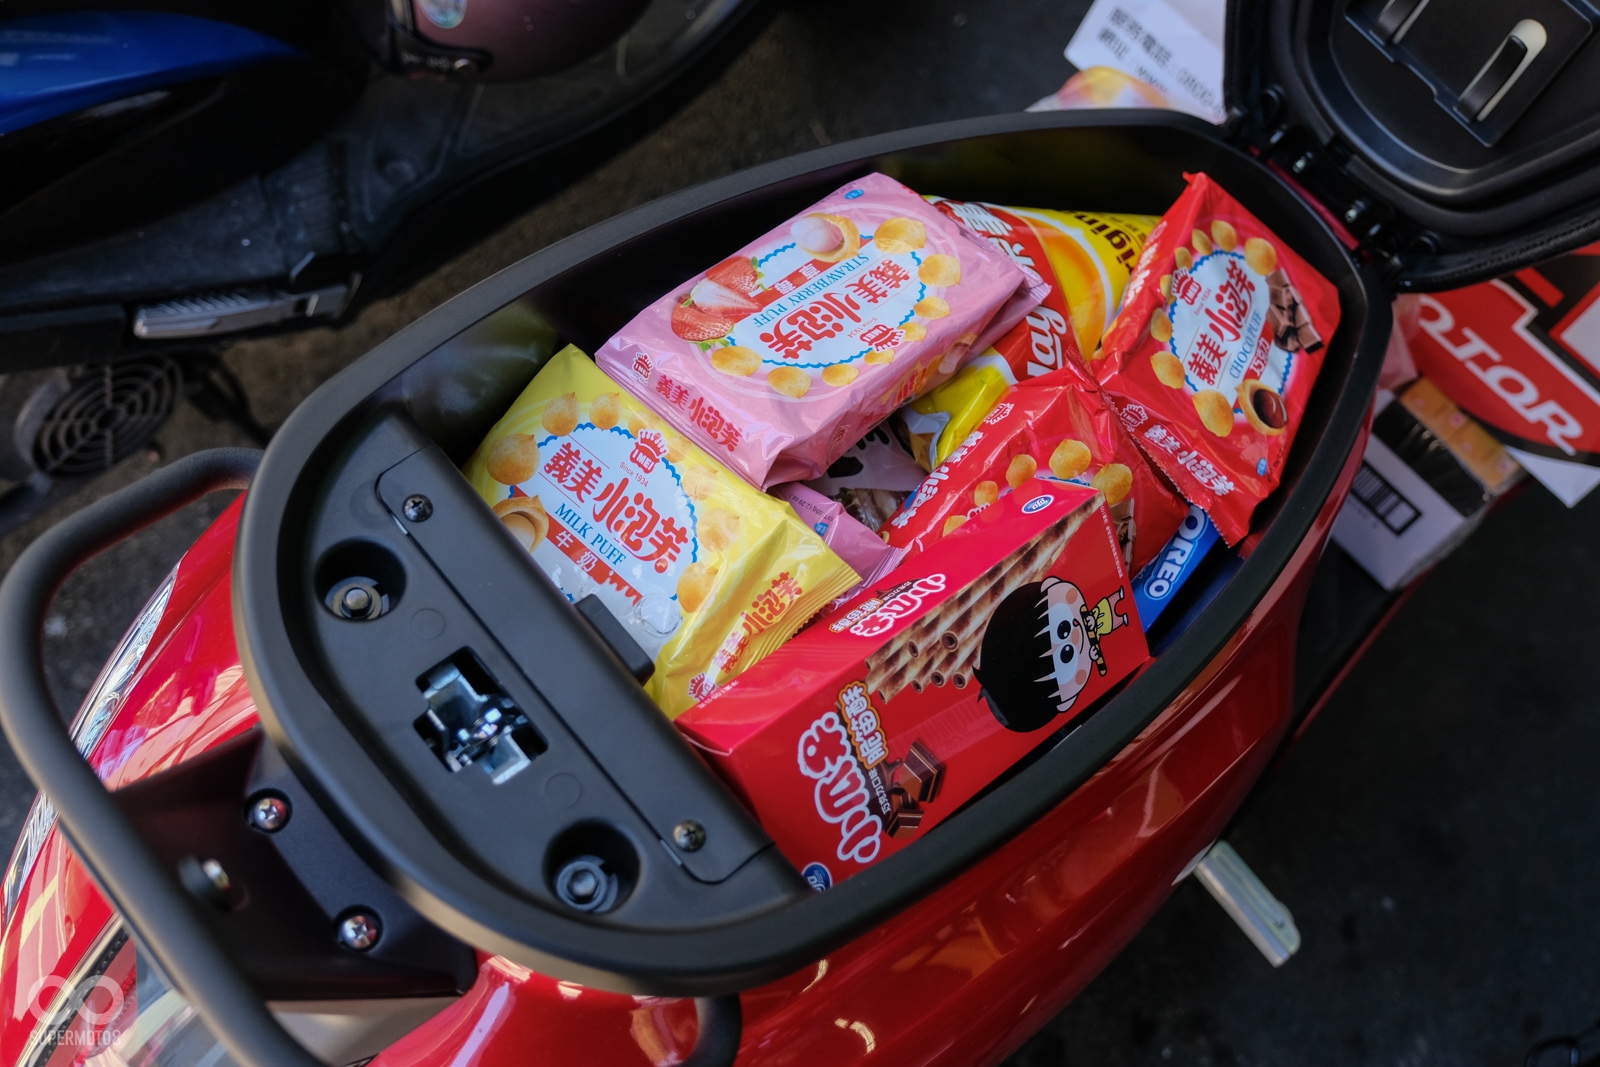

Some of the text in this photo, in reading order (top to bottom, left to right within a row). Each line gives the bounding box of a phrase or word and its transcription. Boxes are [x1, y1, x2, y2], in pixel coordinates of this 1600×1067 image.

[753, 252, 870, 328] STRAWBERRY PUFF
[774, 263, 821, 295] 草莓
[1229, 309, 1262, 379] CHOCO PUFF
[619, 461, 649, 488] Since 1934
[554, 502, 627, 567] MILK PUFF
[555, 531, 595, 573] 牛奶
[1148, 504, 1205, 598] OREO
[842, 685, 885, 766] 脆笛酥
